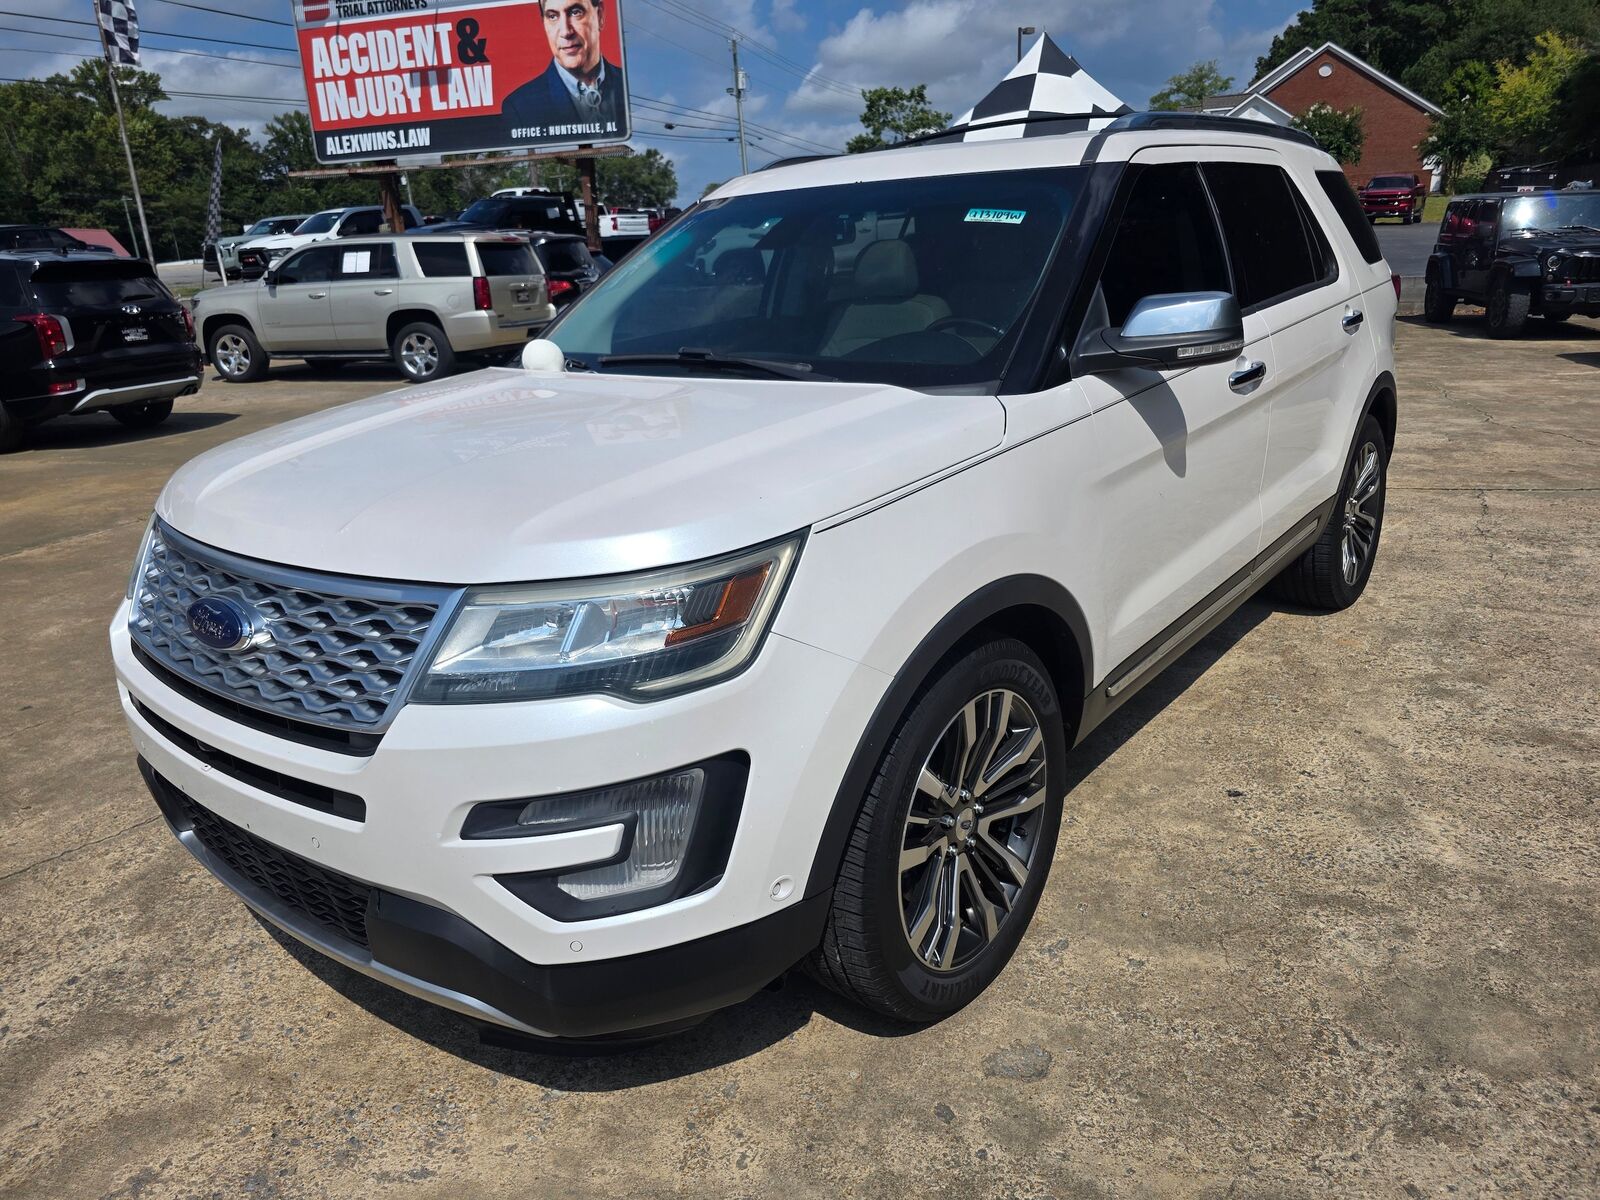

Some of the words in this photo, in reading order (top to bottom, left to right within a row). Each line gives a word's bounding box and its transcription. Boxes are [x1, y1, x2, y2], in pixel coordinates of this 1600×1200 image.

[336, 3, 366, 18] TRIAL
[367, 0, 428, 16] ATTORNEYS
[311, 22, 453, 78] ACCIDENT
[456, 17, 490, 64] &
[315, 72, 421, 122] INJURY
[428, 64, 494, 111] LAW
[326, 127, 431, 155] ALEXWINS.LAW
[511, 127, 541, 139] OFFICE
[548, 123, 604, 136] HUNTSVILLE,
[606, 121, 618, 132] AL
[192, 604, 229, 639] Ford
